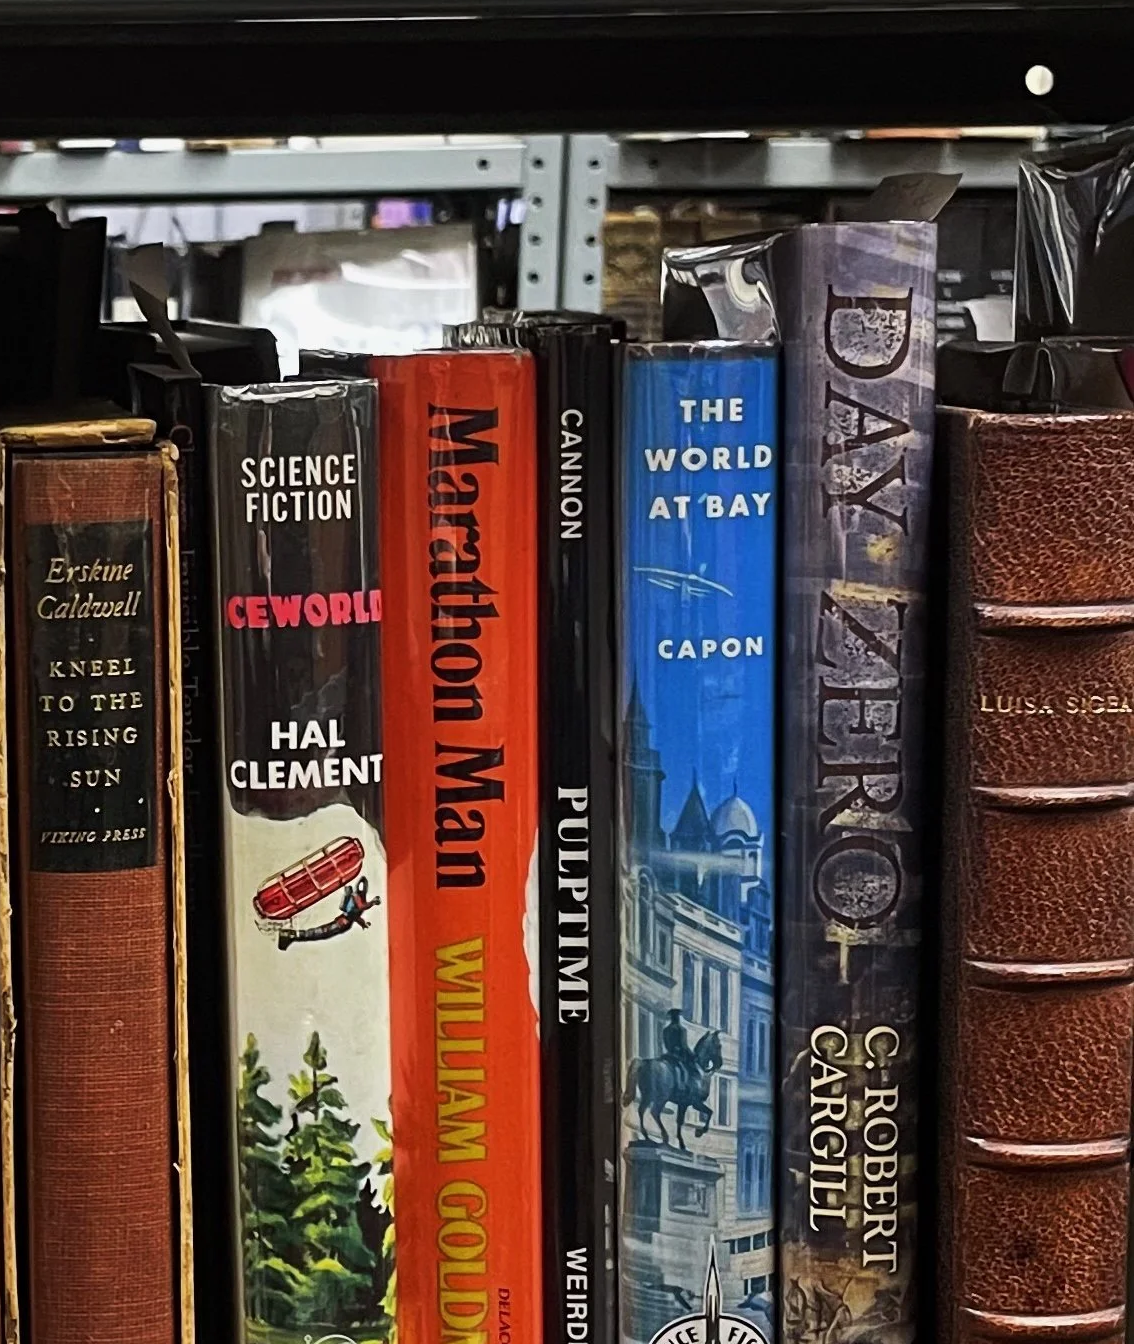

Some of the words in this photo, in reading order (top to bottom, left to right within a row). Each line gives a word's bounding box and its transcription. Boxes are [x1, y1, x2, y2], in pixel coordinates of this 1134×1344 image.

[680, 399, 743, 422] THE
[822, 283, 914, 536] DAY
[241, 455, 355, 488] SCIENCE
[560, 409, 583, 539] CANNON
[645, 446, 772, 472] WORLD
[246, 490, 352, 522] FICTION
[649, 495, 690, 518] AT
[706, 492, 771, 516] BAY
[45, 558, 134, 585] Erskine
[427, 403, 499, 724] Marathon
[37, 592, 140, 621] Caldwell
[658, 637, 763, 659] CAPON
[49, 658, 136, 678] KNEEL
[39, 694, 75, 713] TO
[91, 692, 144, 711] THE
[46, 727, 138, 748] RISING
[271, 719, 345, 751] HAL
[230, 754, 383, 790] CLEMENT
[815, 589, 913, 923] ZERO
[69, 769, 121, 788] SUN
[433, 741, 505, 890] Man
[40, 830, 97, 844] VIKING
[102, 827, 147, 841] PRESS
[557, 786, 589, 1024] PULPTIME
[435, 937, 488, 1165] WILLIAM
[865, 1025, 899, 1068] C.
[808, 1025, 849, 1231] CARGILL
[863, 1083, 899, 1273] ROBERT
